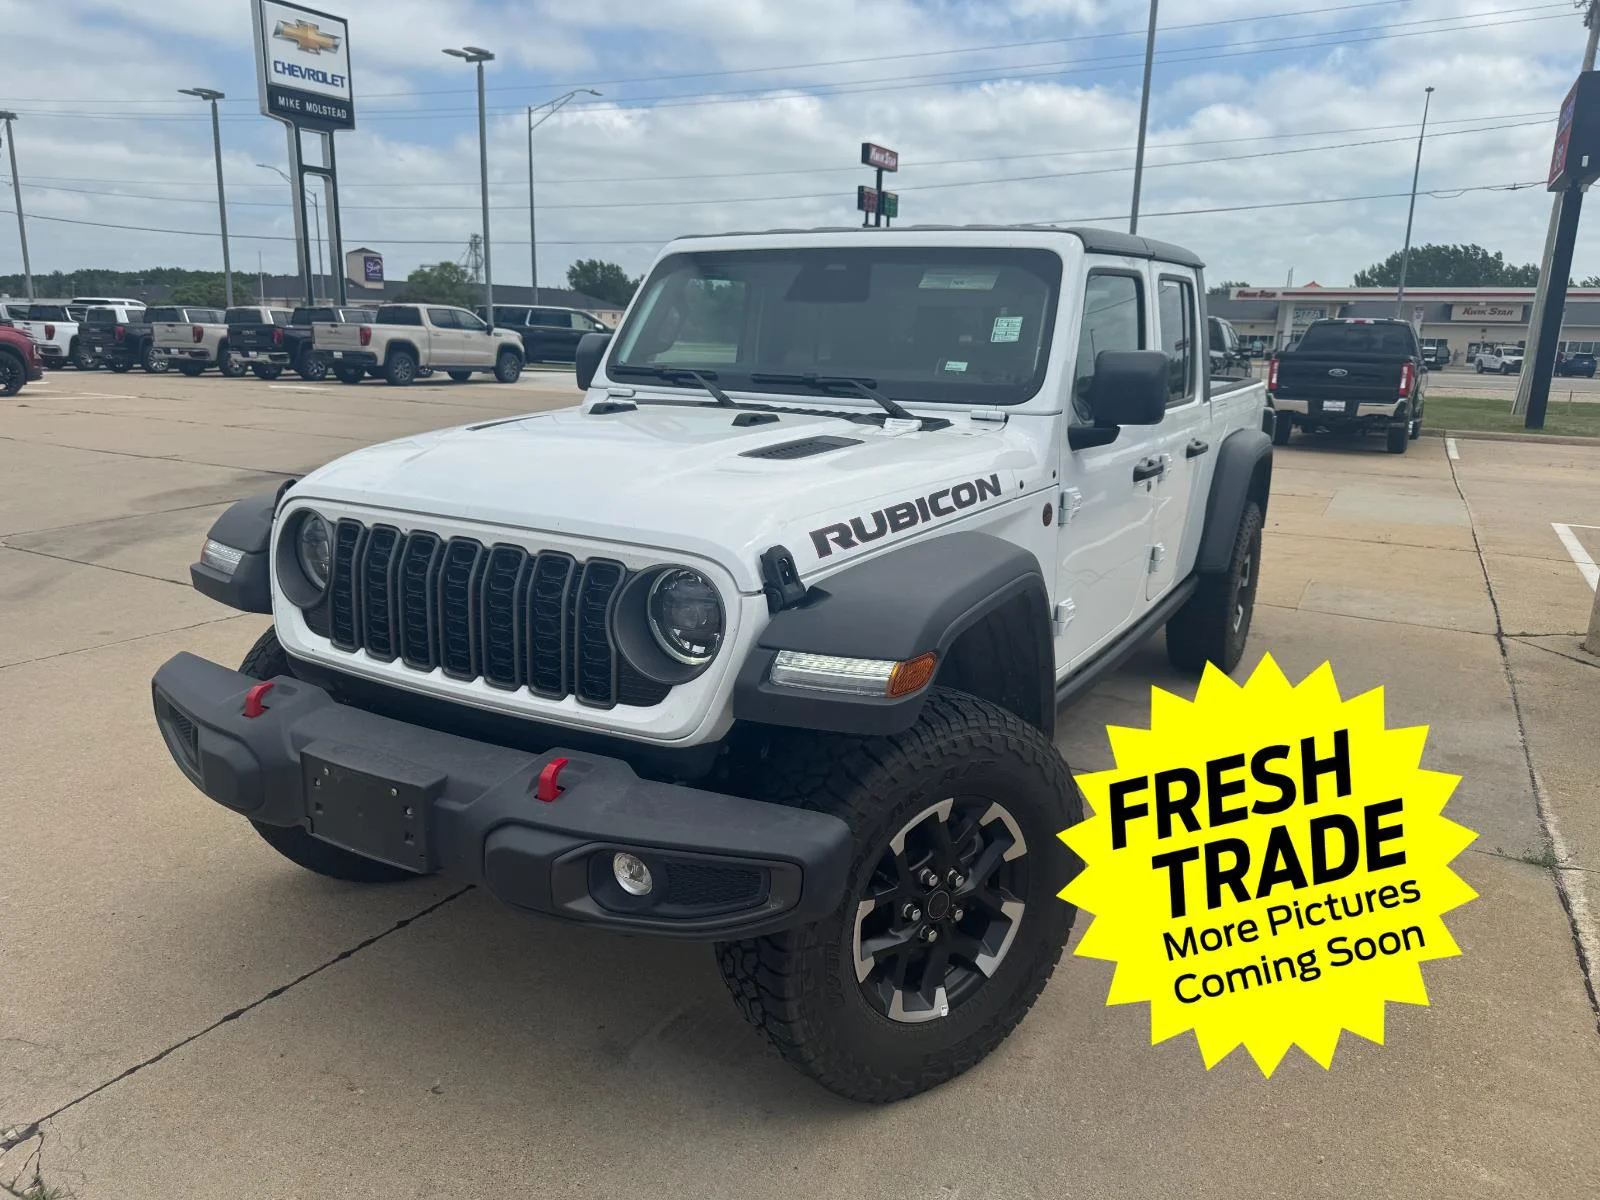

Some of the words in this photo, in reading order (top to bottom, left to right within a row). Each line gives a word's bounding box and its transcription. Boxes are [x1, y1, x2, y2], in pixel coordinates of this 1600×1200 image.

[273, 60, 346, 88] CHEVROLET
[278, 96, 300, 110] MIKE
[305, 102, 347, 119] MOLSTEAD
[809, 473, 1002, 559] RUBICON
